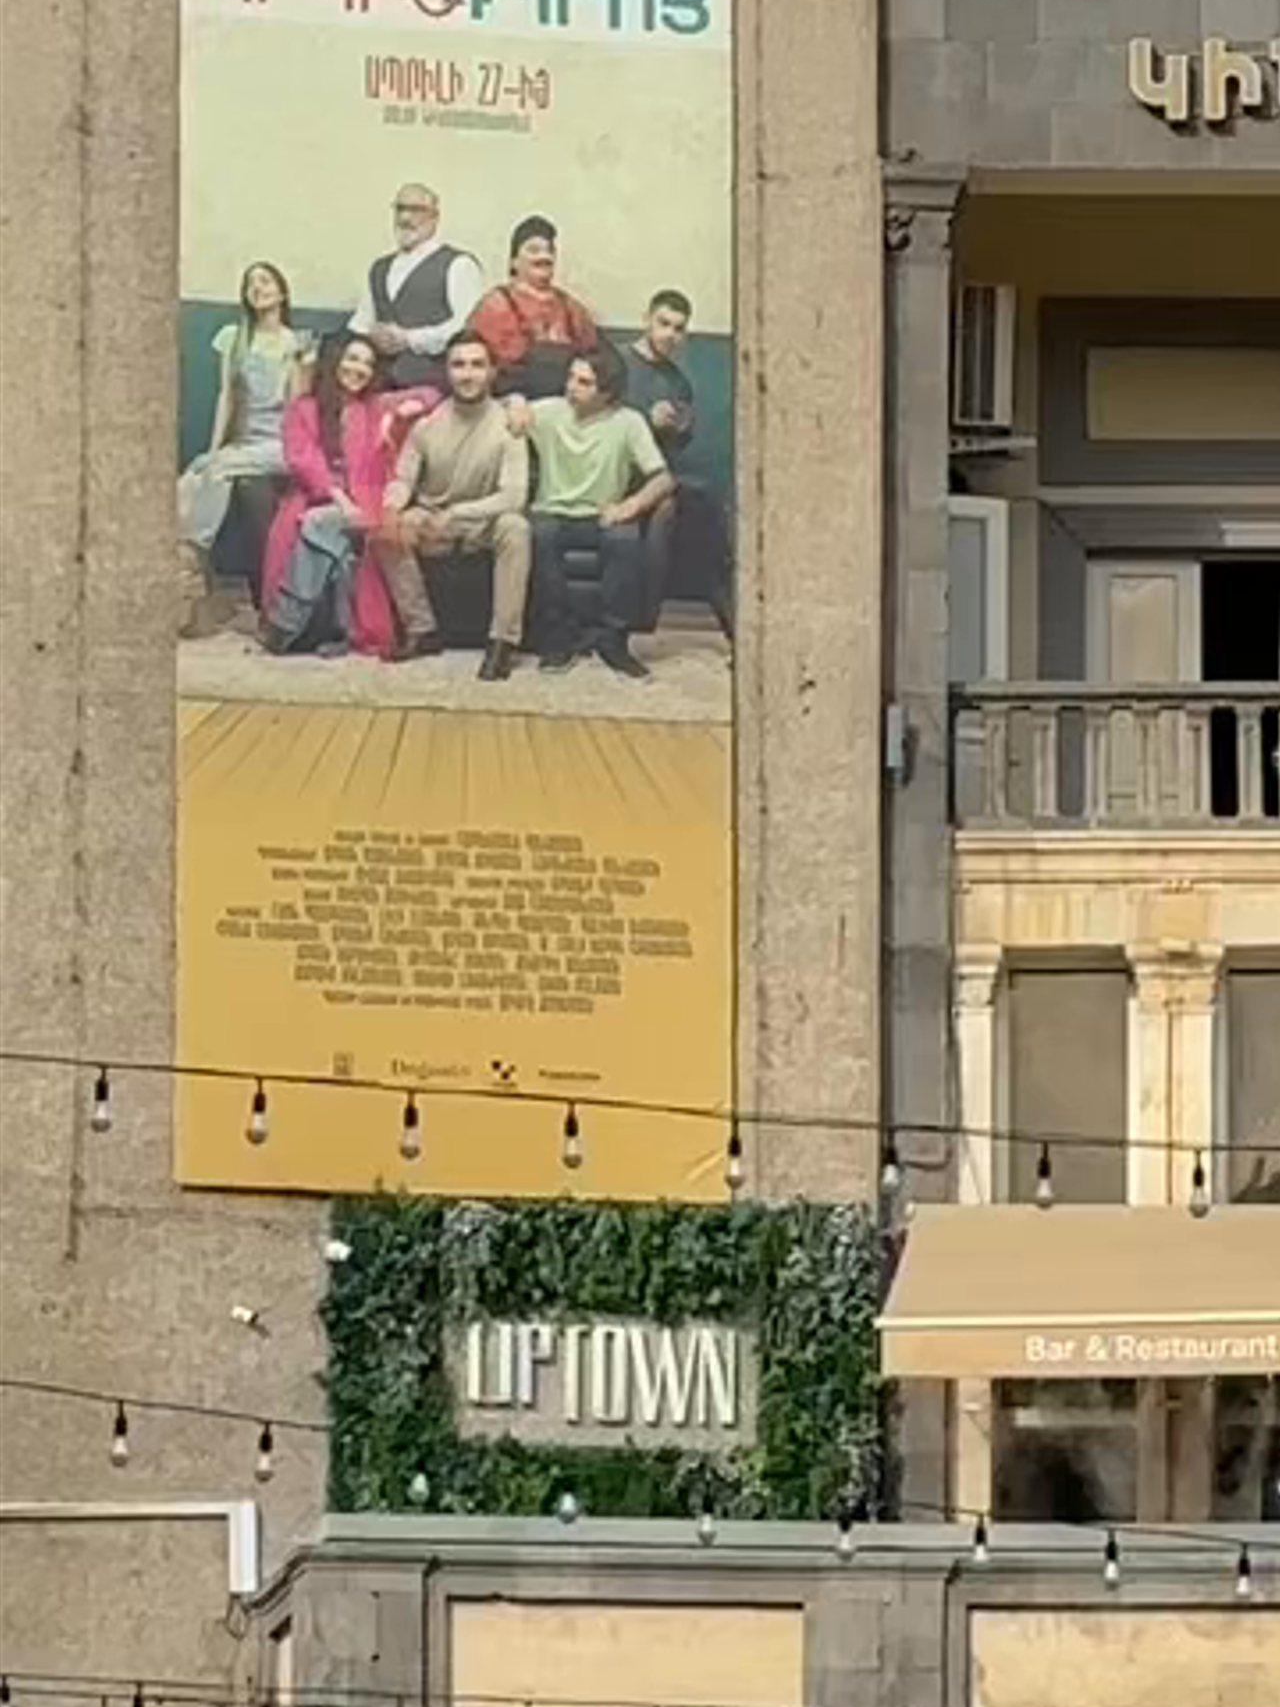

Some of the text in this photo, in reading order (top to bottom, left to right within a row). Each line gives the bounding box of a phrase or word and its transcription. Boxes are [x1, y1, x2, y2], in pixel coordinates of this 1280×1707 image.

[466, 1322, 737, 1427] UPTOWN
[1025, 1334, 1279, 1362] Bar & Restaurant
